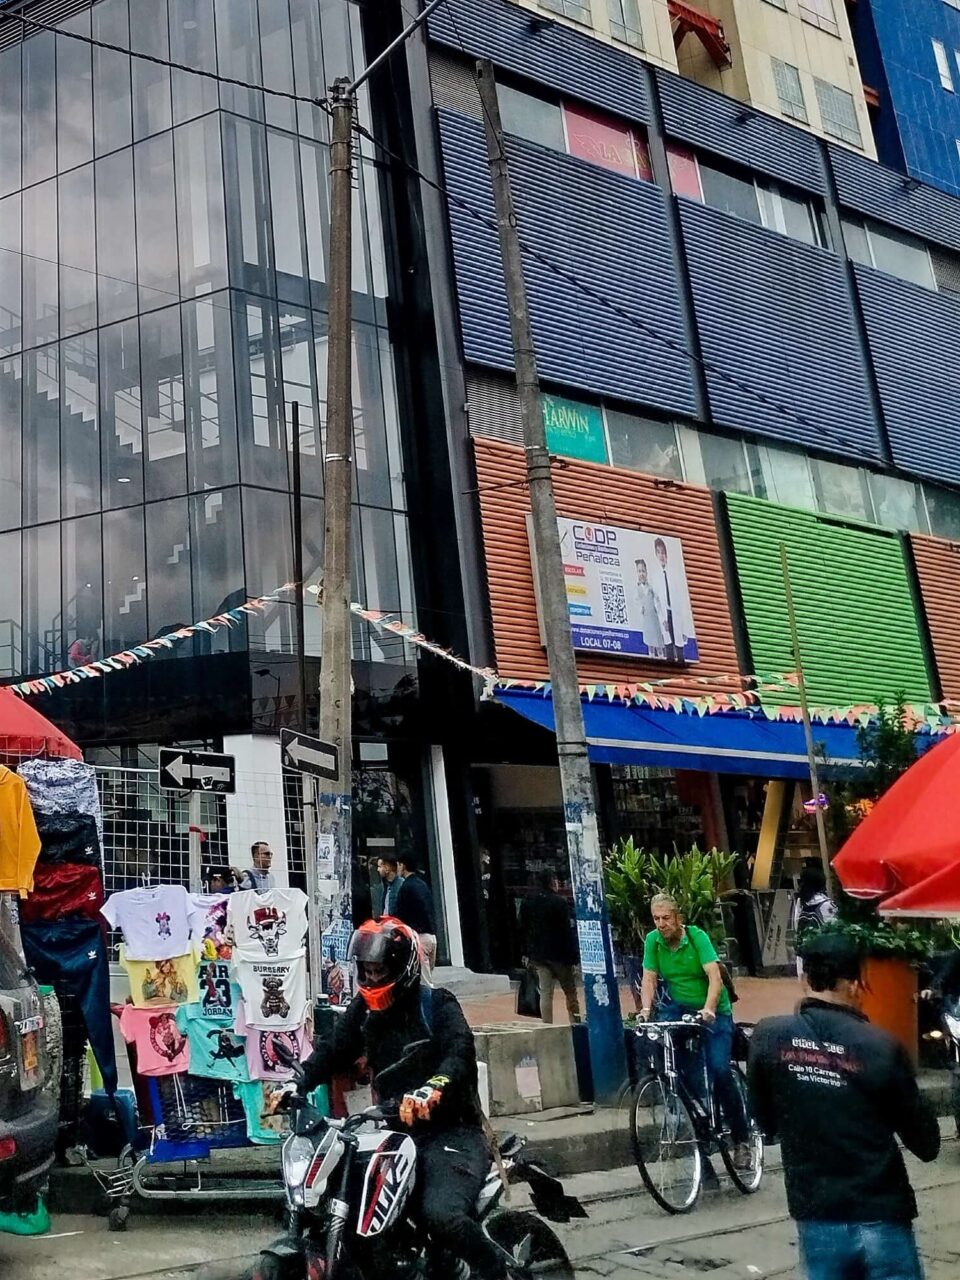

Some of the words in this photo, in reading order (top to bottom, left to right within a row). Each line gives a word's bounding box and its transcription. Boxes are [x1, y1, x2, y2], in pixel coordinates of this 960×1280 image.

[576, 551, 620, 566] Peñaloza
[580, 636, 603, 648] LOCAL
[603, 638, 622, 651] 07-08
[253, 965, 291, 974] BURBERRY
[199, 978, 233, 1008] 23
[202, 1006, 234, 1019] JORDAN
[788, 1064, 804, 1073] Calle
[805, 1065, 813, 1073] 10
[810, 1075, 840, 1087] Victorino
